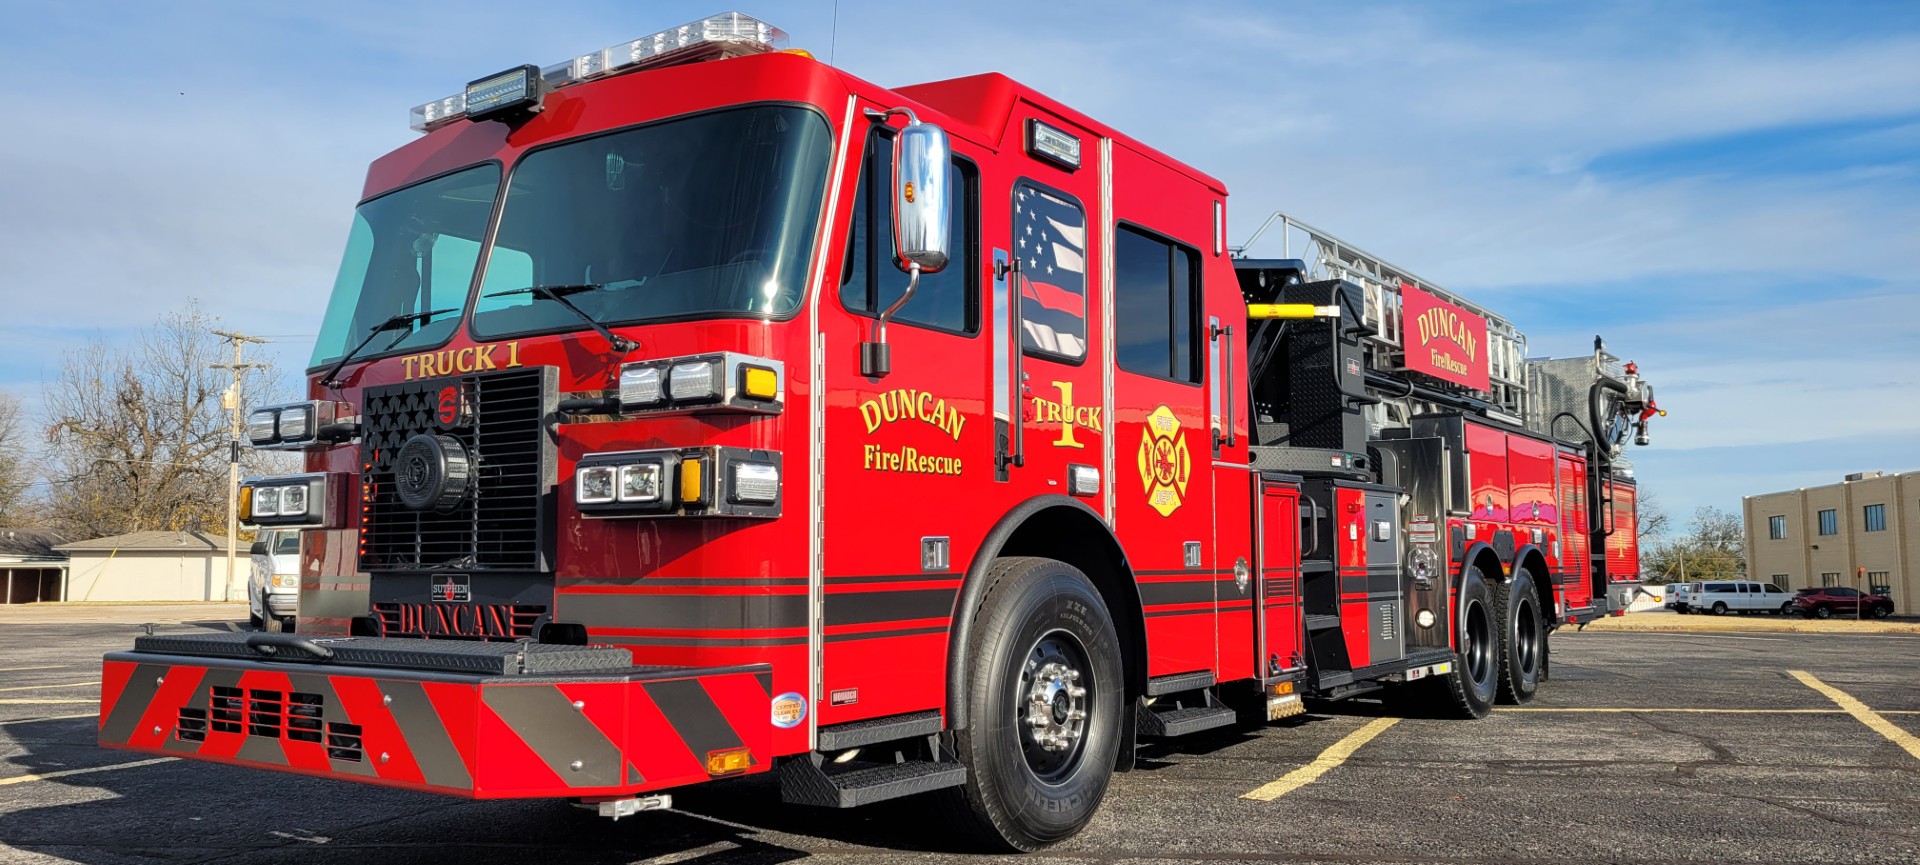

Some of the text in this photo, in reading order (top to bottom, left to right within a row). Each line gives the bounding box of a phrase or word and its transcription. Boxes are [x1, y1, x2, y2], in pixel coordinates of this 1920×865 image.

[1417, 307, 1476, 364] DUNCAN
[401, 341, 523, 381] TRUCK 1
[1431, 348, 1468, 376] Fire/Rescue
[859, 389, 966, 442] DUNCAN
[1032, 397, 1103, 433] TRUCK
[1052, 381, 1085, 449] 1
[864, 444, 962, 475] Fire/Rescue
[400, 603, 508, 638] DUNCAN
